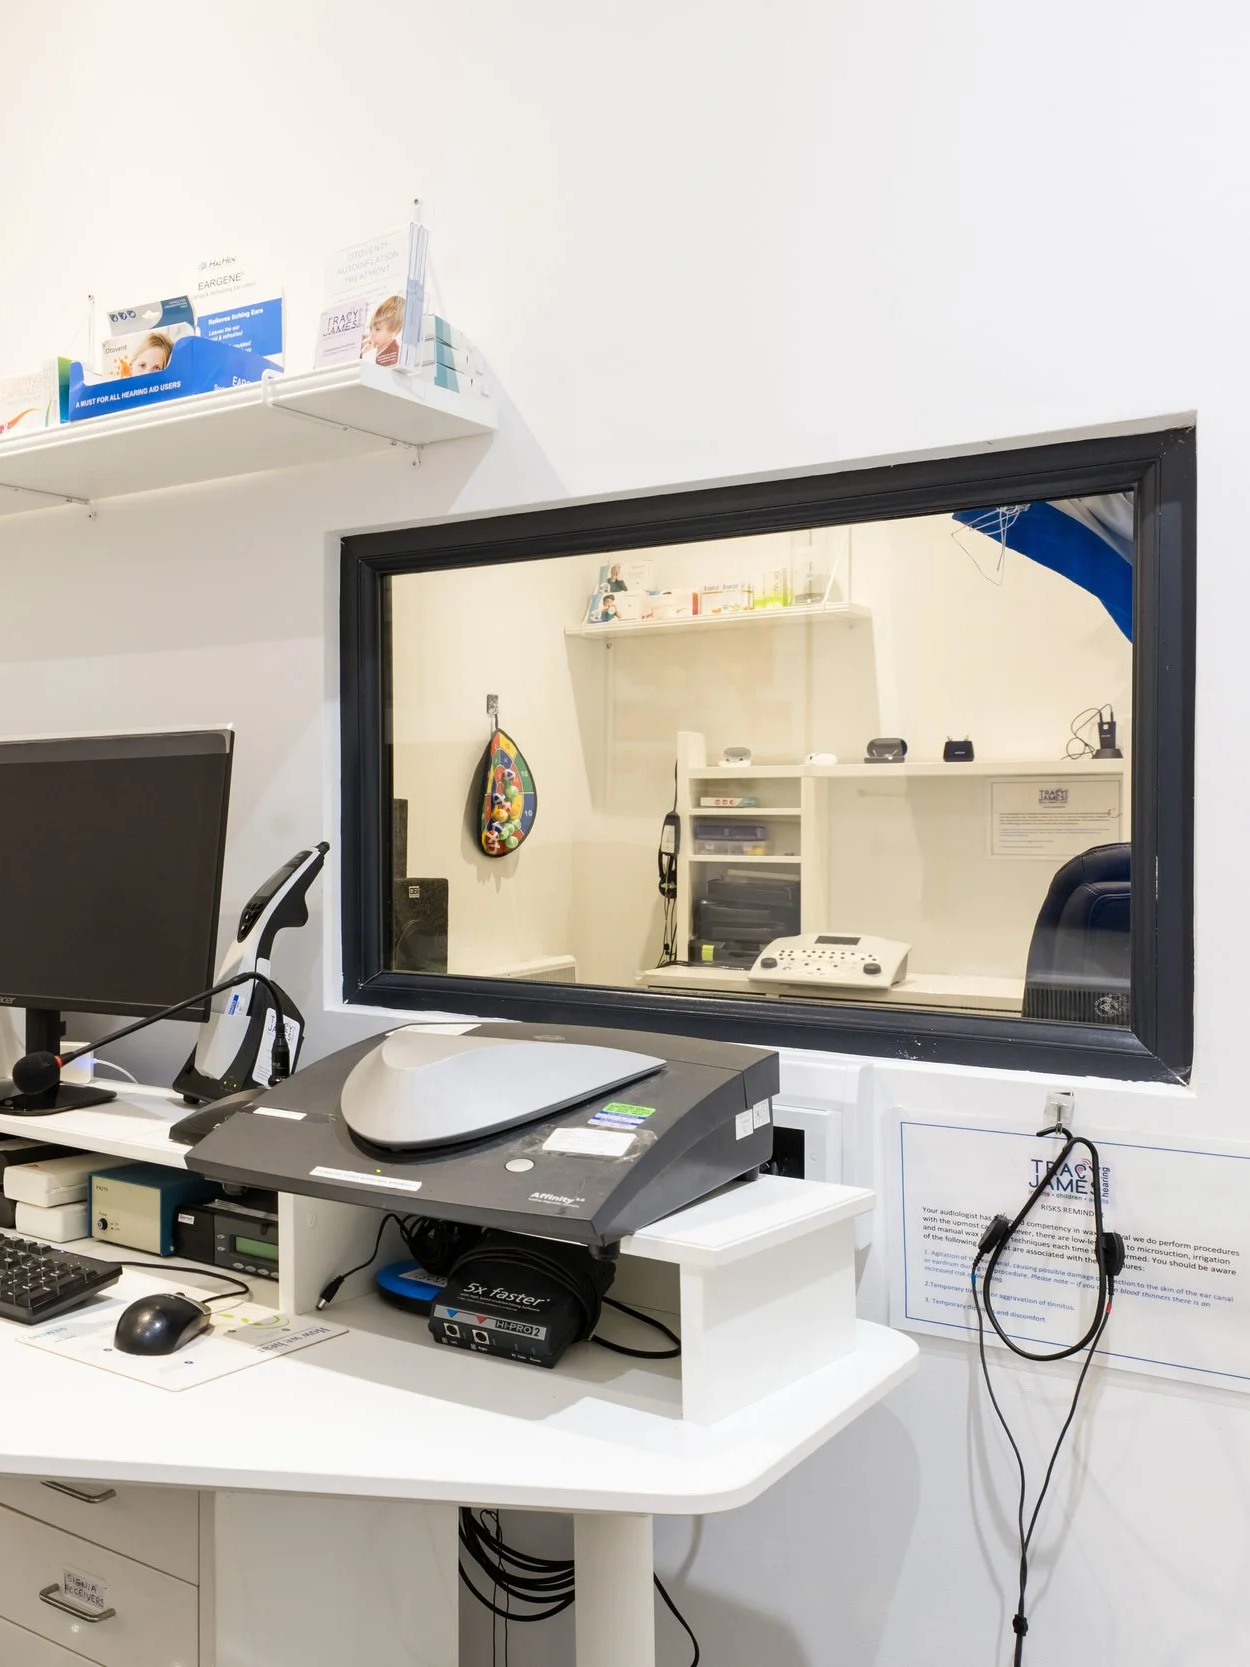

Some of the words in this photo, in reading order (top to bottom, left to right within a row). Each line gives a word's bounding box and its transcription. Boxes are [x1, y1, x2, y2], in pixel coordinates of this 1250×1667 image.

[336, 250, 398, 276] AUTOINFLATION
[198, 272, 242, 290] EARGENE
[106, 344, 128, 354] Otovent
[80, 398, 97, 406] MUST
[97, 396, 109, 404] FOR
[122, 388, 148, 399] HEARING
[160, 381, 182, 391] USERS
[1102, 1166, 1110, 1198] hearing
[530, 1192, 574, 1204] Affinity
[1056, 1194, 1082, 1202] children
[1041, 1204, 1062, 1213] RISKS
[1063, 1206, 1104, 1218] REMIND
[922, 1206, 938, 1214] Your
[940, 1210, 978, 1220] audiologist
[1027, 1220, 1072, 1234] competency
[1159, 1240, 1192, 1251] perform
[1194, 1245, 1240, 1258] procedures
[952, 1221, 977, 1230] upmost
[1036, 1232, 1056, 1240] there
[1137, 1246, 1190, 1260] microsuction,
[1193, 1254, 1230, 1266] irrigation
[940, 1226, 964, 1235] manual
[1011, 1237, 1050, 1249] techniques
[1052, 1243, 1070, 1251] each
[1152, 1256, 1167, 1265] You
[1170, 1260, 1196, 1270] should
[1198, 1264, 1208, 1272] be
[1211, 1268, 1237, 1276] aware
[946, 1236, 978, 1248] following
[1026, 1249, 1064, 1260] associated
[924, 1266, 954, 1275] increased
[932, 1250, 960, 1260] Agitation
[1013, 1264, 1037, 1273] causing
[1038, 1266, 1066, 1277] possible
[1067, 1272, 1094, 1281] damage
[1146, 1283, 1159, 1291] the
[1160, 1285, 1174, 1294] skin
[1185, 1289, 1198, 1297] the
[1214, 1294, 1234, 1302] canal
[463, 1282, 488, 1295] 5x
[490, 1288, 545, 1306] faster
[994, 1269, 1029, 1280] procedure.
[1031, 1274, 1052, 1282] Please
[1120, 1288, 1140, 1296] blood
[1142, 1291, 1170, 1302] thinners
[1172, 1296, 1192, 1305] there
[932, 1298, 967, 1310] Temporary
[1010, 1312, 1046, 1322] discomfort.
[1000, 1294, 1038, 1305] aggravation
[1048, 1302, 1076, 1311] tinnitus.
[496, 1320, 532, 1334] HI-PRO
[533, 1328, 540, 1337] 2
[65, 1584, 104, 1608] RECEIVERS
[67, 1574, 96, 1594] SIGNIA
